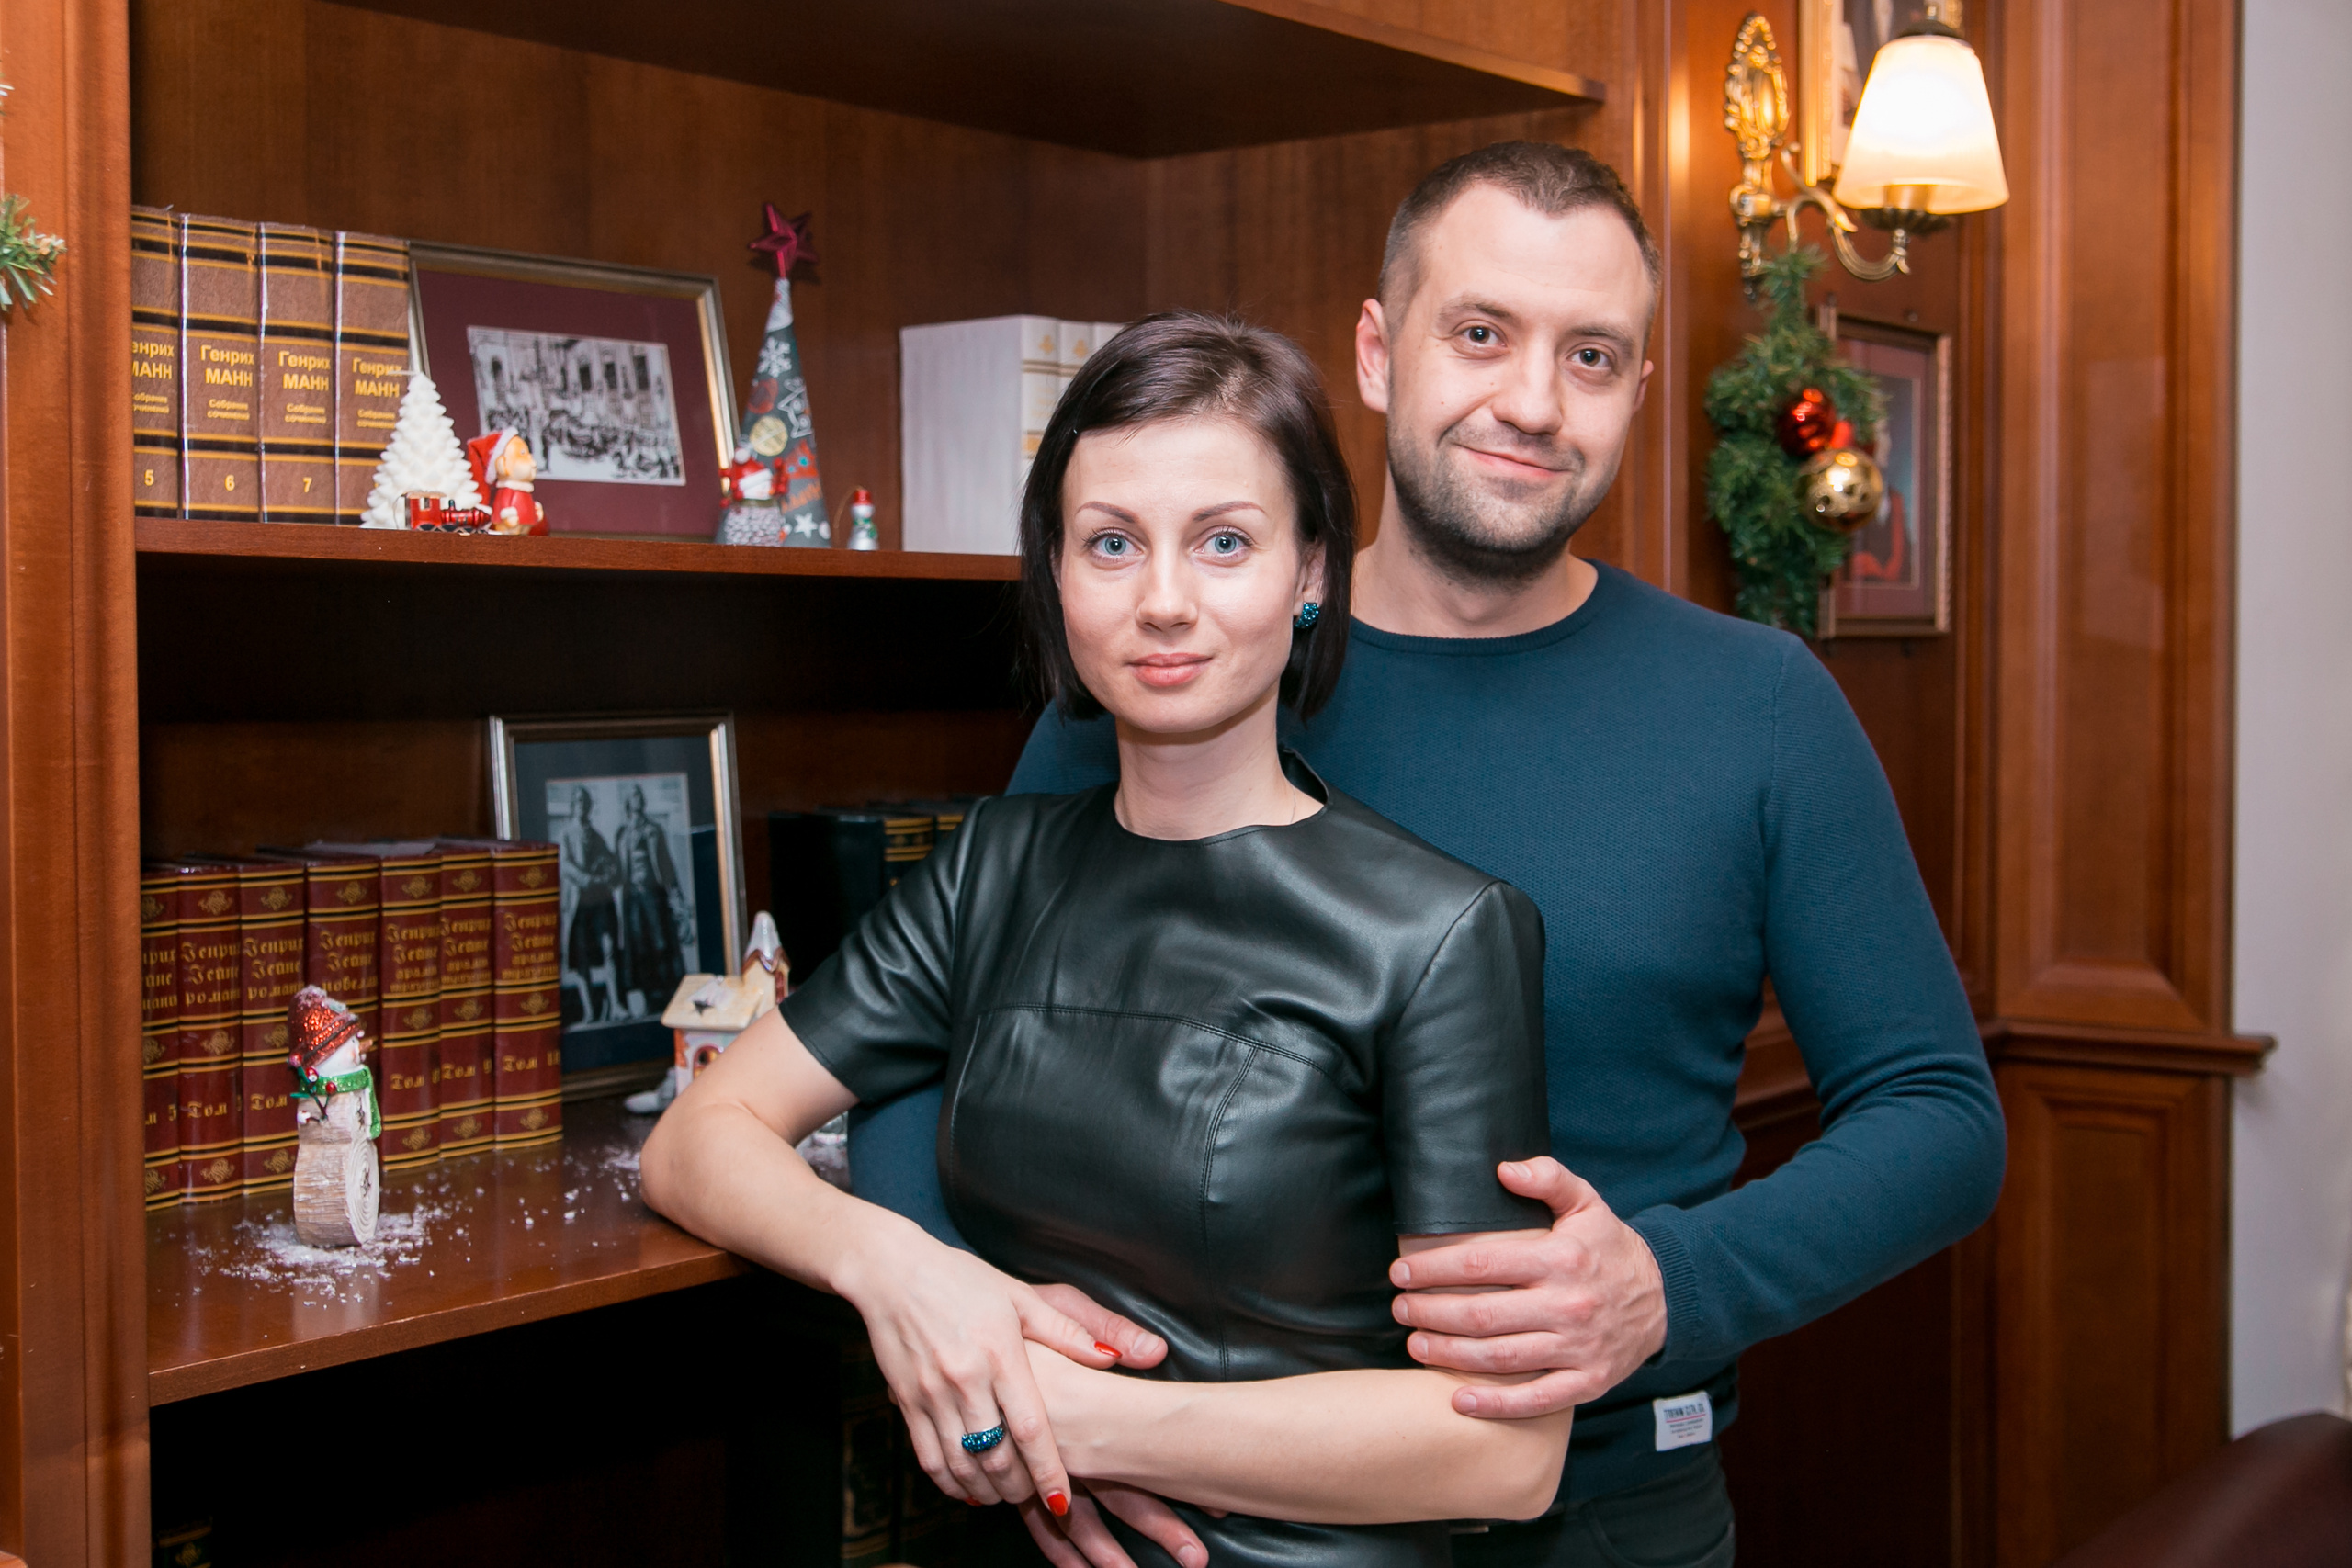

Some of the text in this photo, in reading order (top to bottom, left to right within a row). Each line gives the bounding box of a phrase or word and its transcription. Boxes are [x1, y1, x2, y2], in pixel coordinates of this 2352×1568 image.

[200, 344, 254, 367] Генрих
[278, 351, 331, 371] Генрих
[352, 357, 402, 378] Генрих
[205, 368, 253, 387] МАНН
[283, 374, 329, 391] МАНН
[355, 379, 400, 398] МАНН
[133, 392, 168, 404] обрание
[144, 469, 154, 486] 5
[224, 474, 235, 491] 6
[303, 477, 312, 493] 7
[181, 941, 240, 963] Генри
[441, 1063, 476, 1079] Том
[503, 1055, 538, 1072] Том
[390, 1073, 425, 1090] Том
[187, 1100, 228, 1118] Том
[250, 1093, 288, 1111] Том
